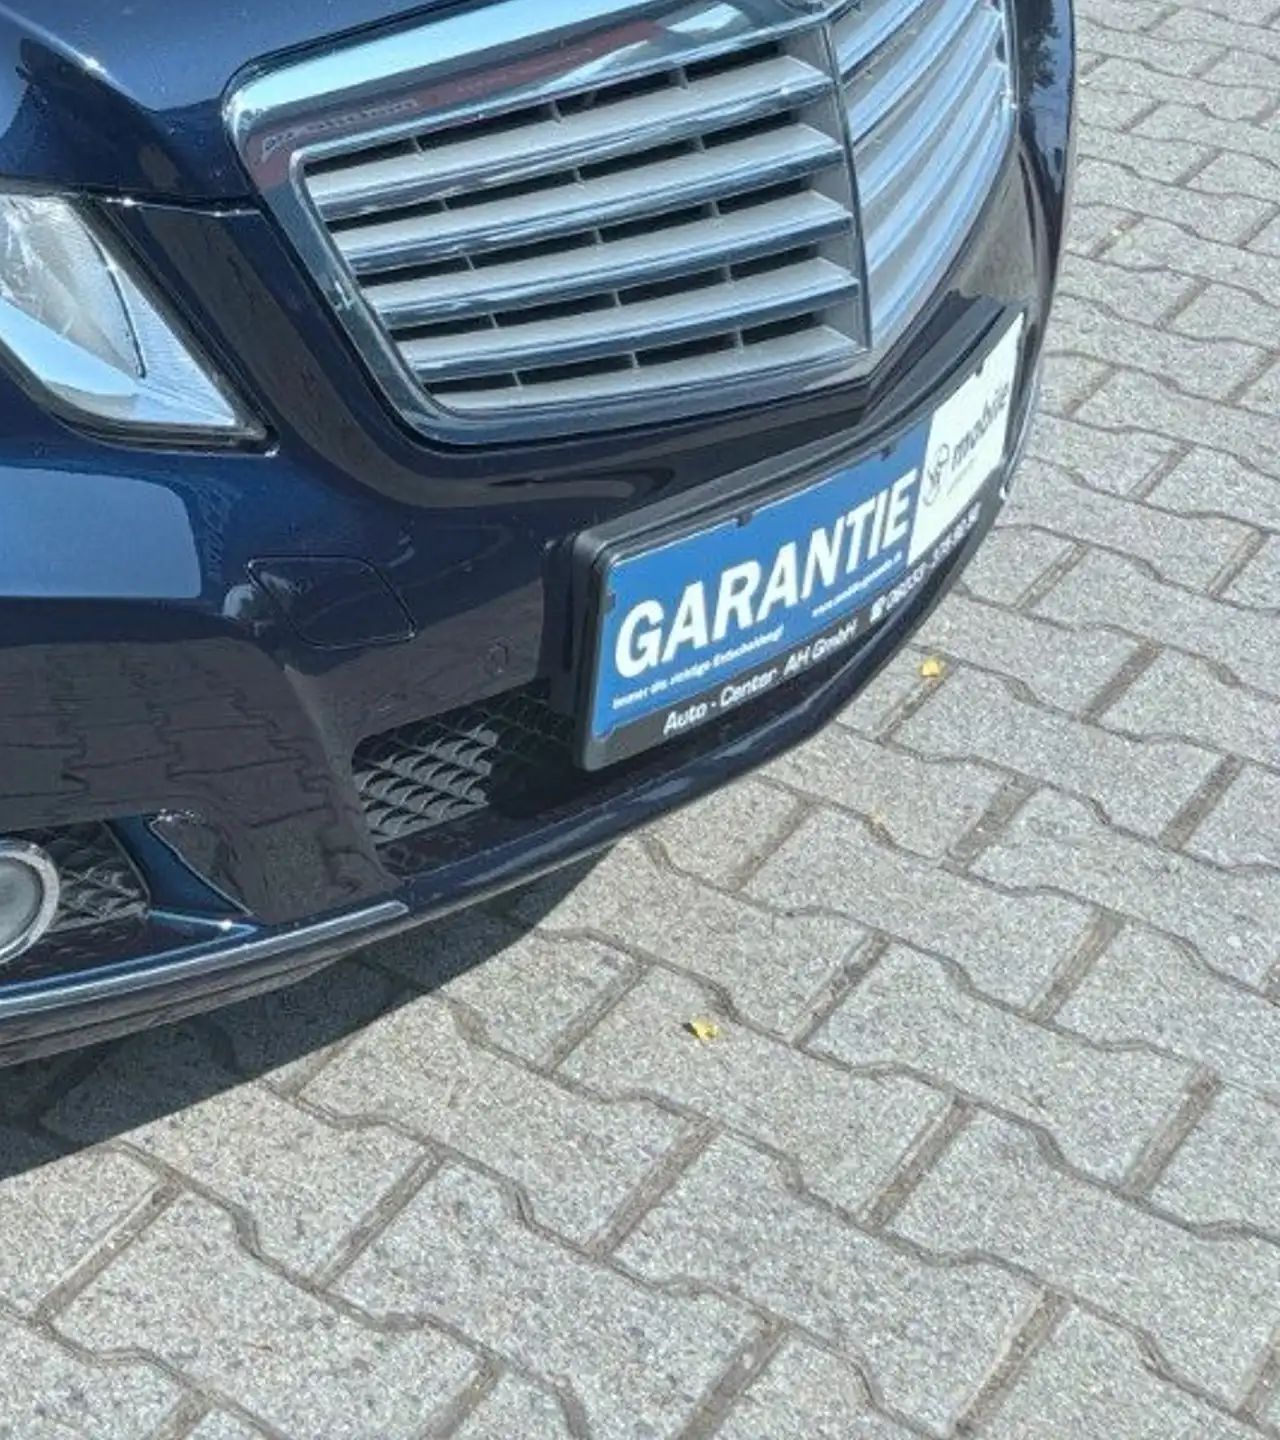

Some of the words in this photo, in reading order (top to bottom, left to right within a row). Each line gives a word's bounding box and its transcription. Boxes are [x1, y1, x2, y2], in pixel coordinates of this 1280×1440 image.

[612, 468, 919, 679] GARANTIE
[663, 701, 707, 736] Auto
[720, 666, 778, 708] Center
[783, 646, 811, 677] AH
[812, 617, 858, 657] GmbH
